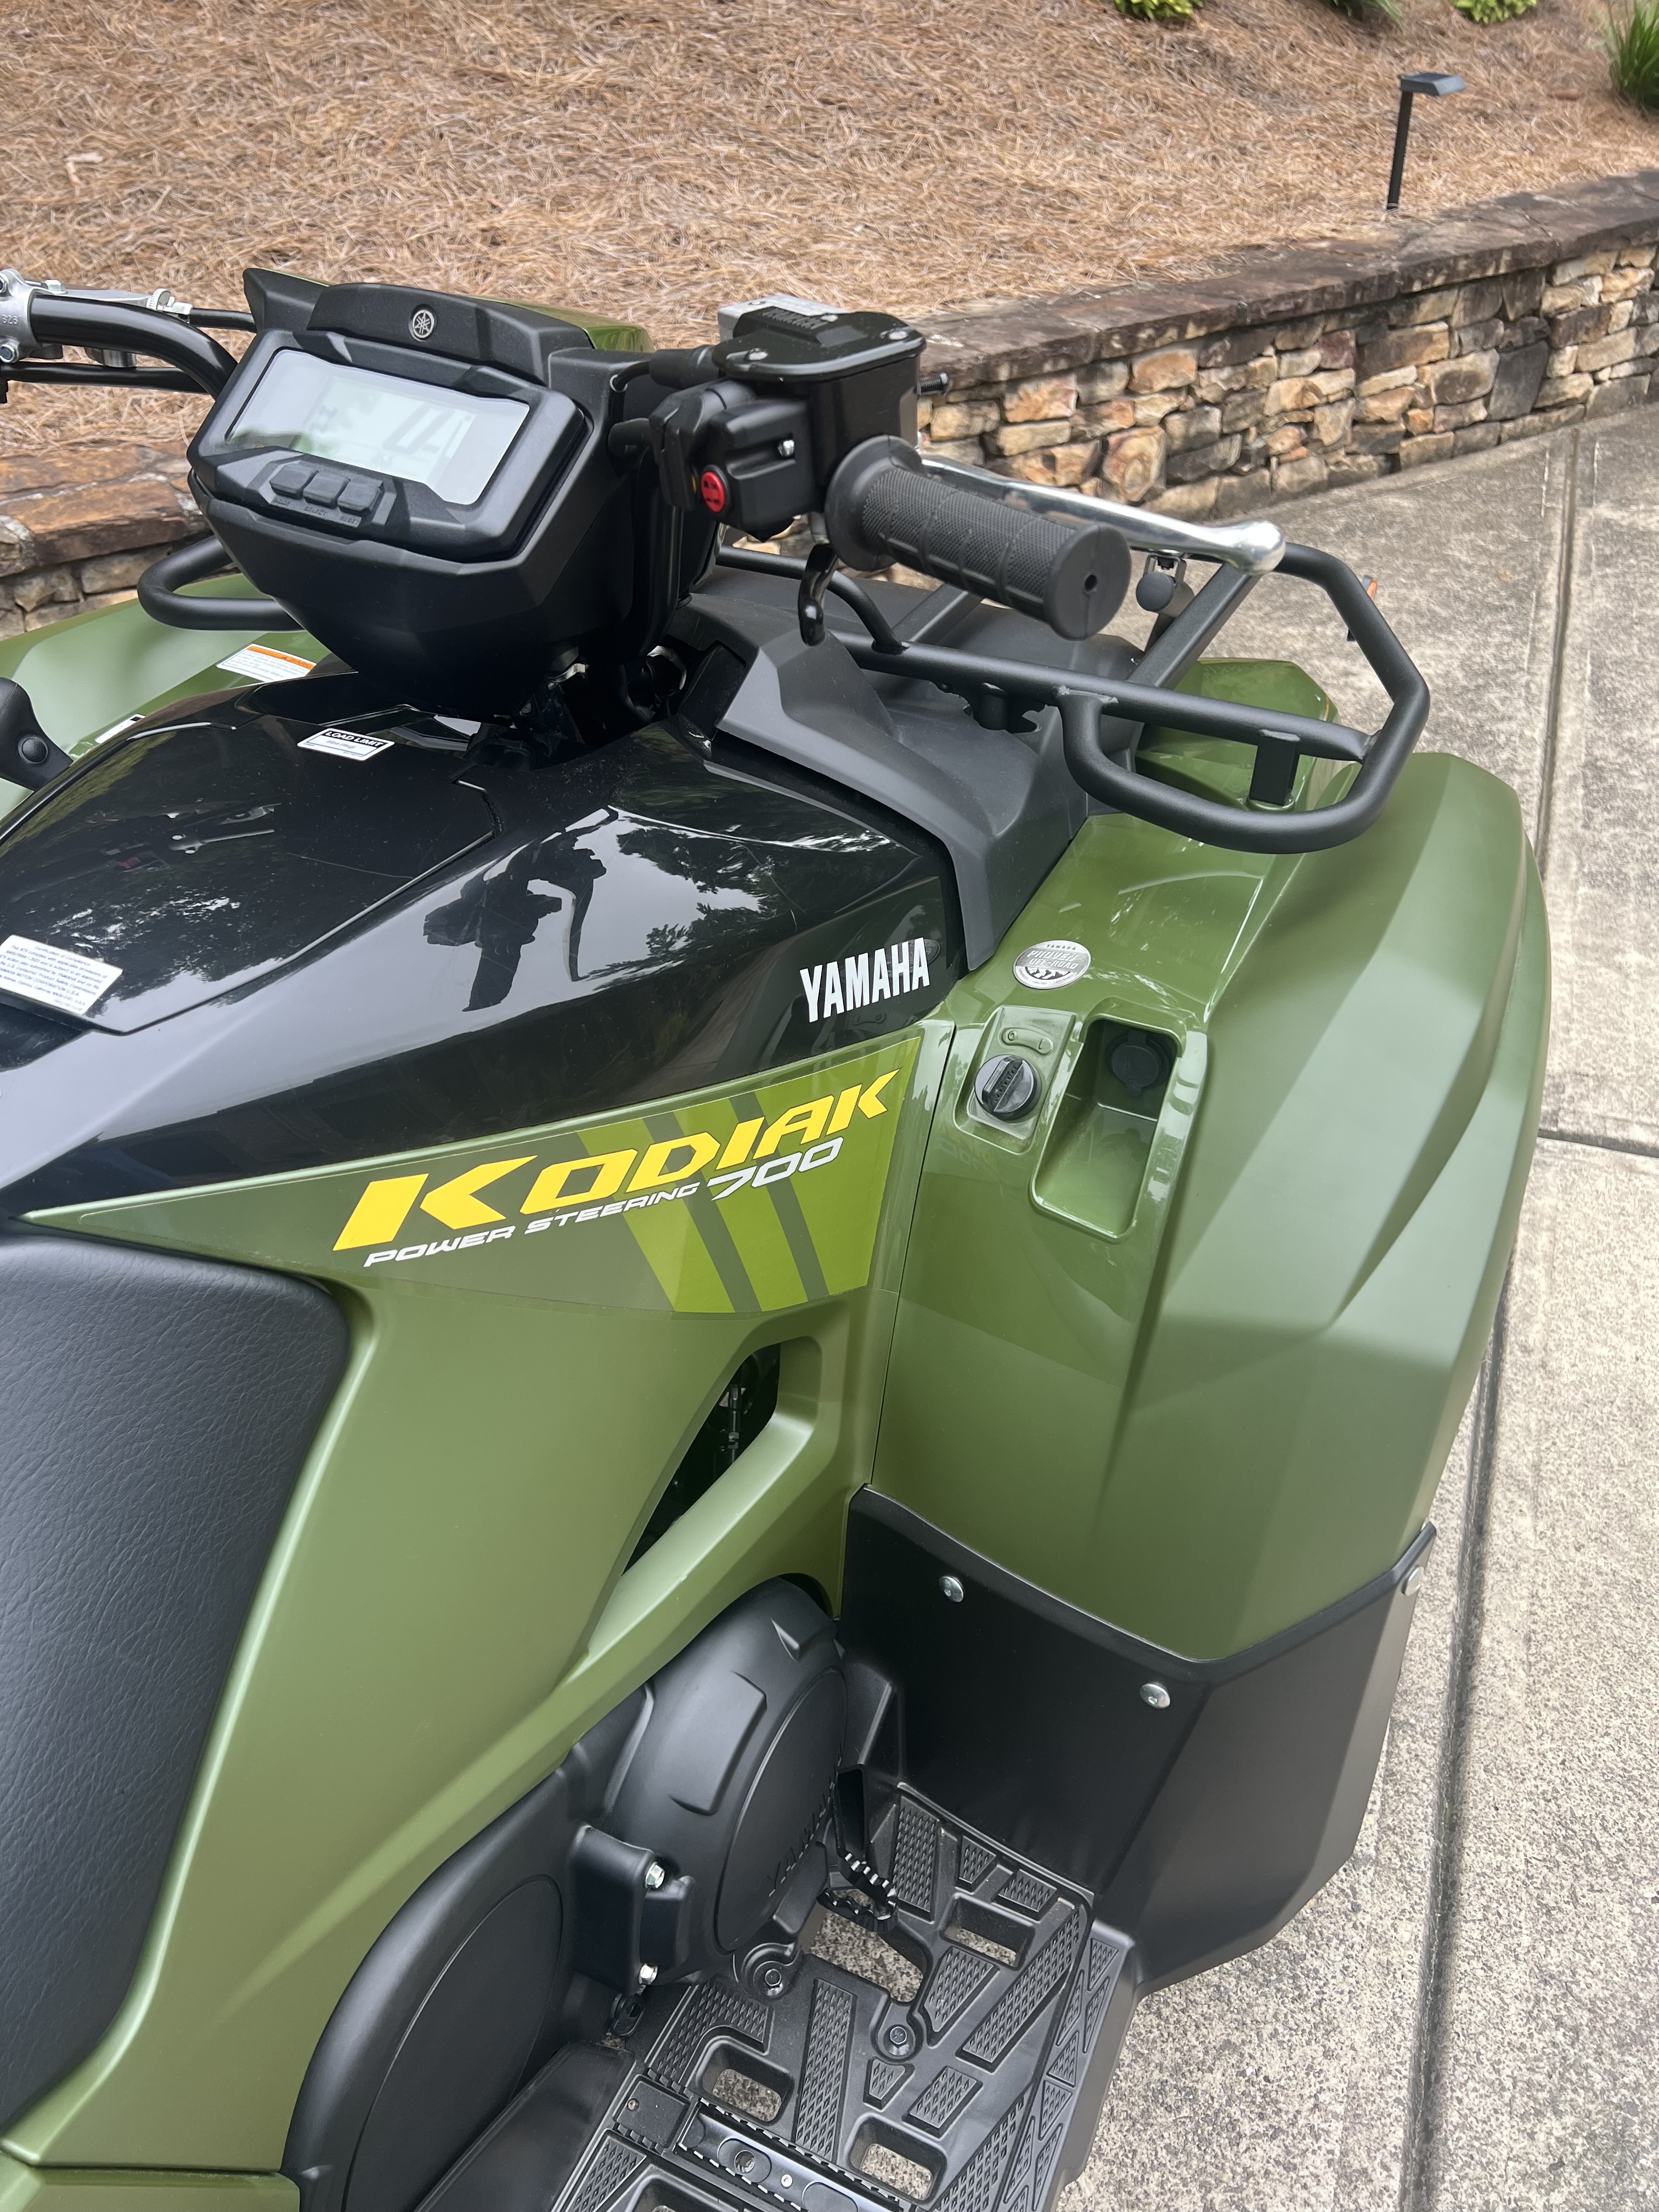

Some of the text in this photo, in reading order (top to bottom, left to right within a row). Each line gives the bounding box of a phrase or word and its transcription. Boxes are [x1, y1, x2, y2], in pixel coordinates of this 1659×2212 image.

[325, 731, 384, 747] LOAD LIMIT
[799, 937, 930, 1023] YAMAHA
[1026, 950, 1079, 962] PROVEN
[1029, 958, 1079, 969] OFF-ROAD
[332, 1069, 900, 1251] KODIAK
[363, 1137, 844, 1267] POWER STEERING 700
